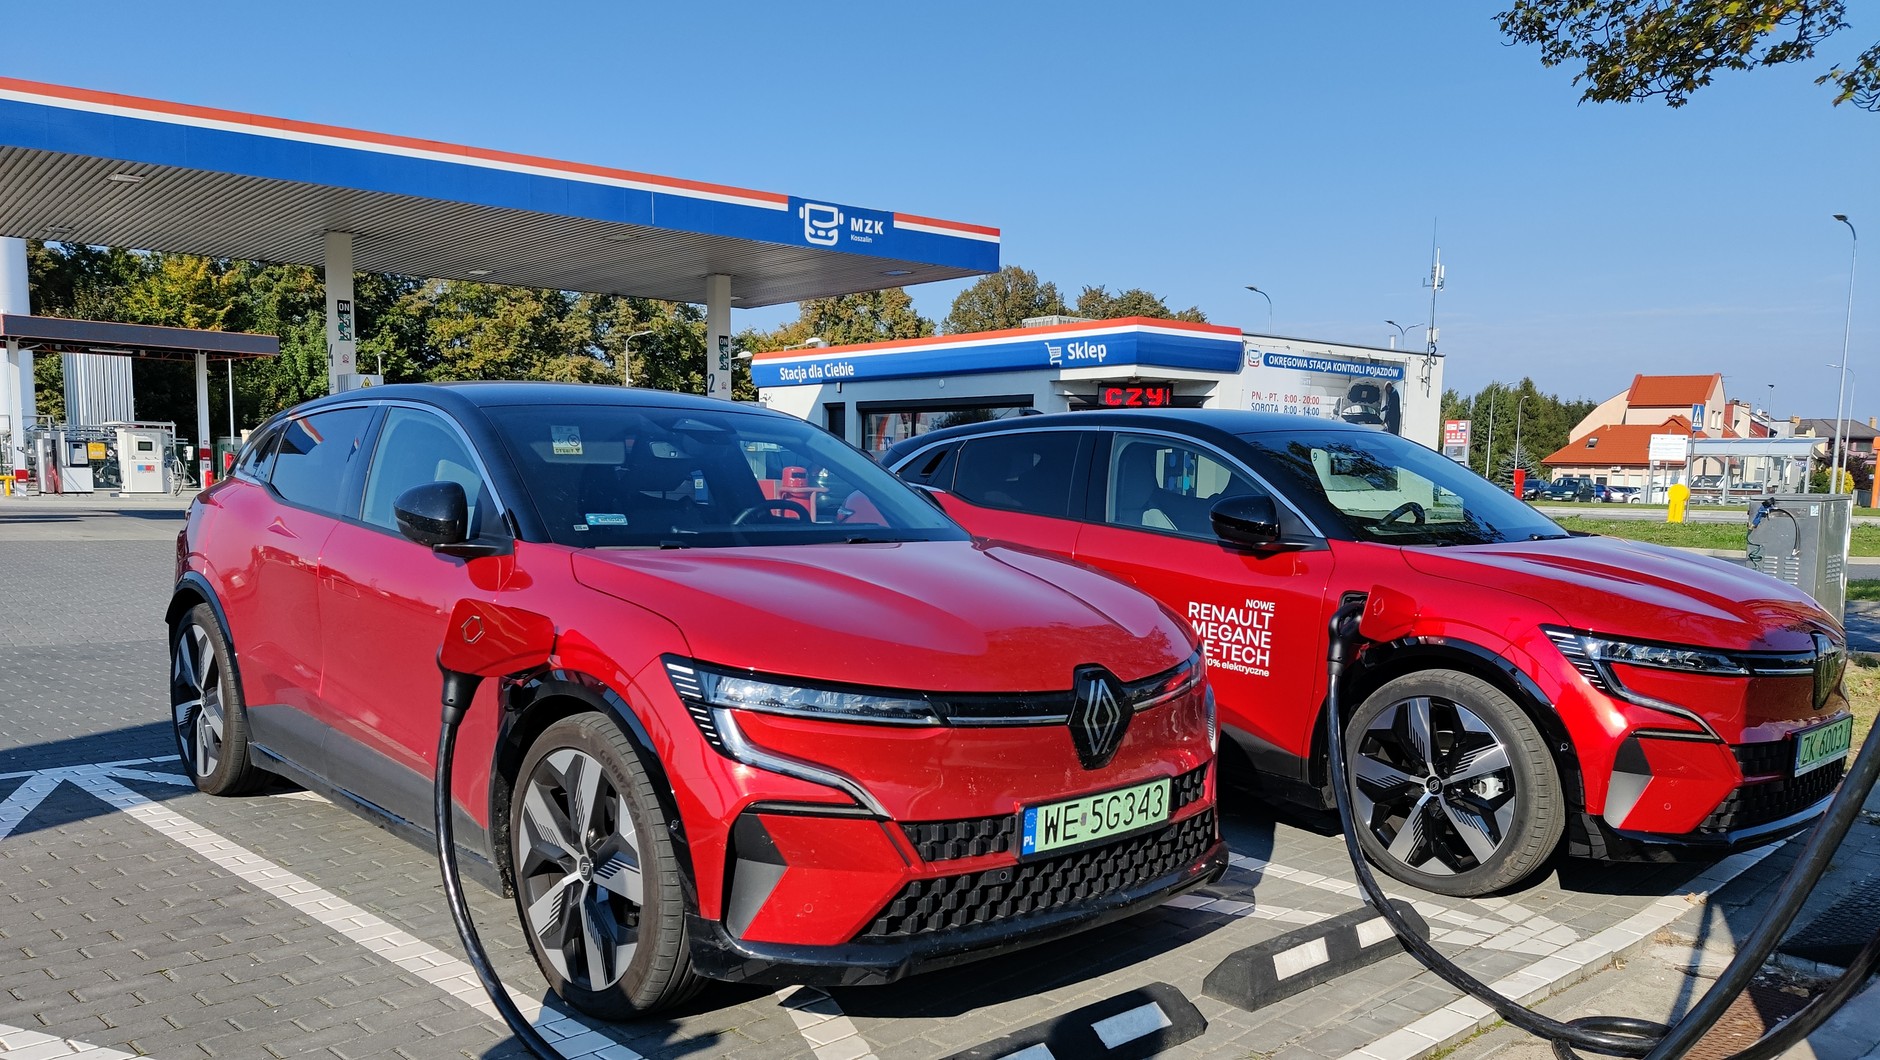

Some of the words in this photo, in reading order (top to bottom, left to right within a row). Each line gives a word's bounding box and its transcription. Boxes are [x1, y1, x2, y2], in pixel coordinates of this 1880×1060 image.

[850, 217, 884, 235] MZK
[850, 234, 873, 243] Koszalin
[338, 302, 350, 312] ON
[1067, 341, 1107, 362] Sklep
[779, 365, 807, 383] Stacja
[808, 363, 823, 379] dla
[824, 361, 855, 377] Ciebie
[1268, 355, 1308, 368] OKRĘGOWA
[1309, 360, 1332, 373] STACJA
[1332, 362, 1365, 375] KONTROLI
[1365, 364, 1400, 378] POJAZDÓW
[708, 373, 715, 393] 2
[1105, 387, 1170, 406] CZY
[1251, 391, 1263, 401] PN.
[1268, 392, 1279, 402] PT.
[1283, 394, 1298, 403] 8:00
[1302, 395, 1320, 405] 20:00
[1250, 402, 1279, 413] SOBOTA
[1283, 405, 1298, 415] 8:00
[1302, 406, 1320, 417] 14:00
[1245, 598, 1276, 612] NOWE
[1188, 601, 1275, 630] RENAULT
[1192, 620, 1272, 649] MEGANE
[1204, 639, 1270, 667] E-TECH
[1221, 661, 1270, 677] elektryczne
[1801, 733, 1818, 765] ZK
[1023, 835, 1035, 847] PL
[1044, 803, 1080, 845] WE
[1090, 784, 1164, 834] 5G343
